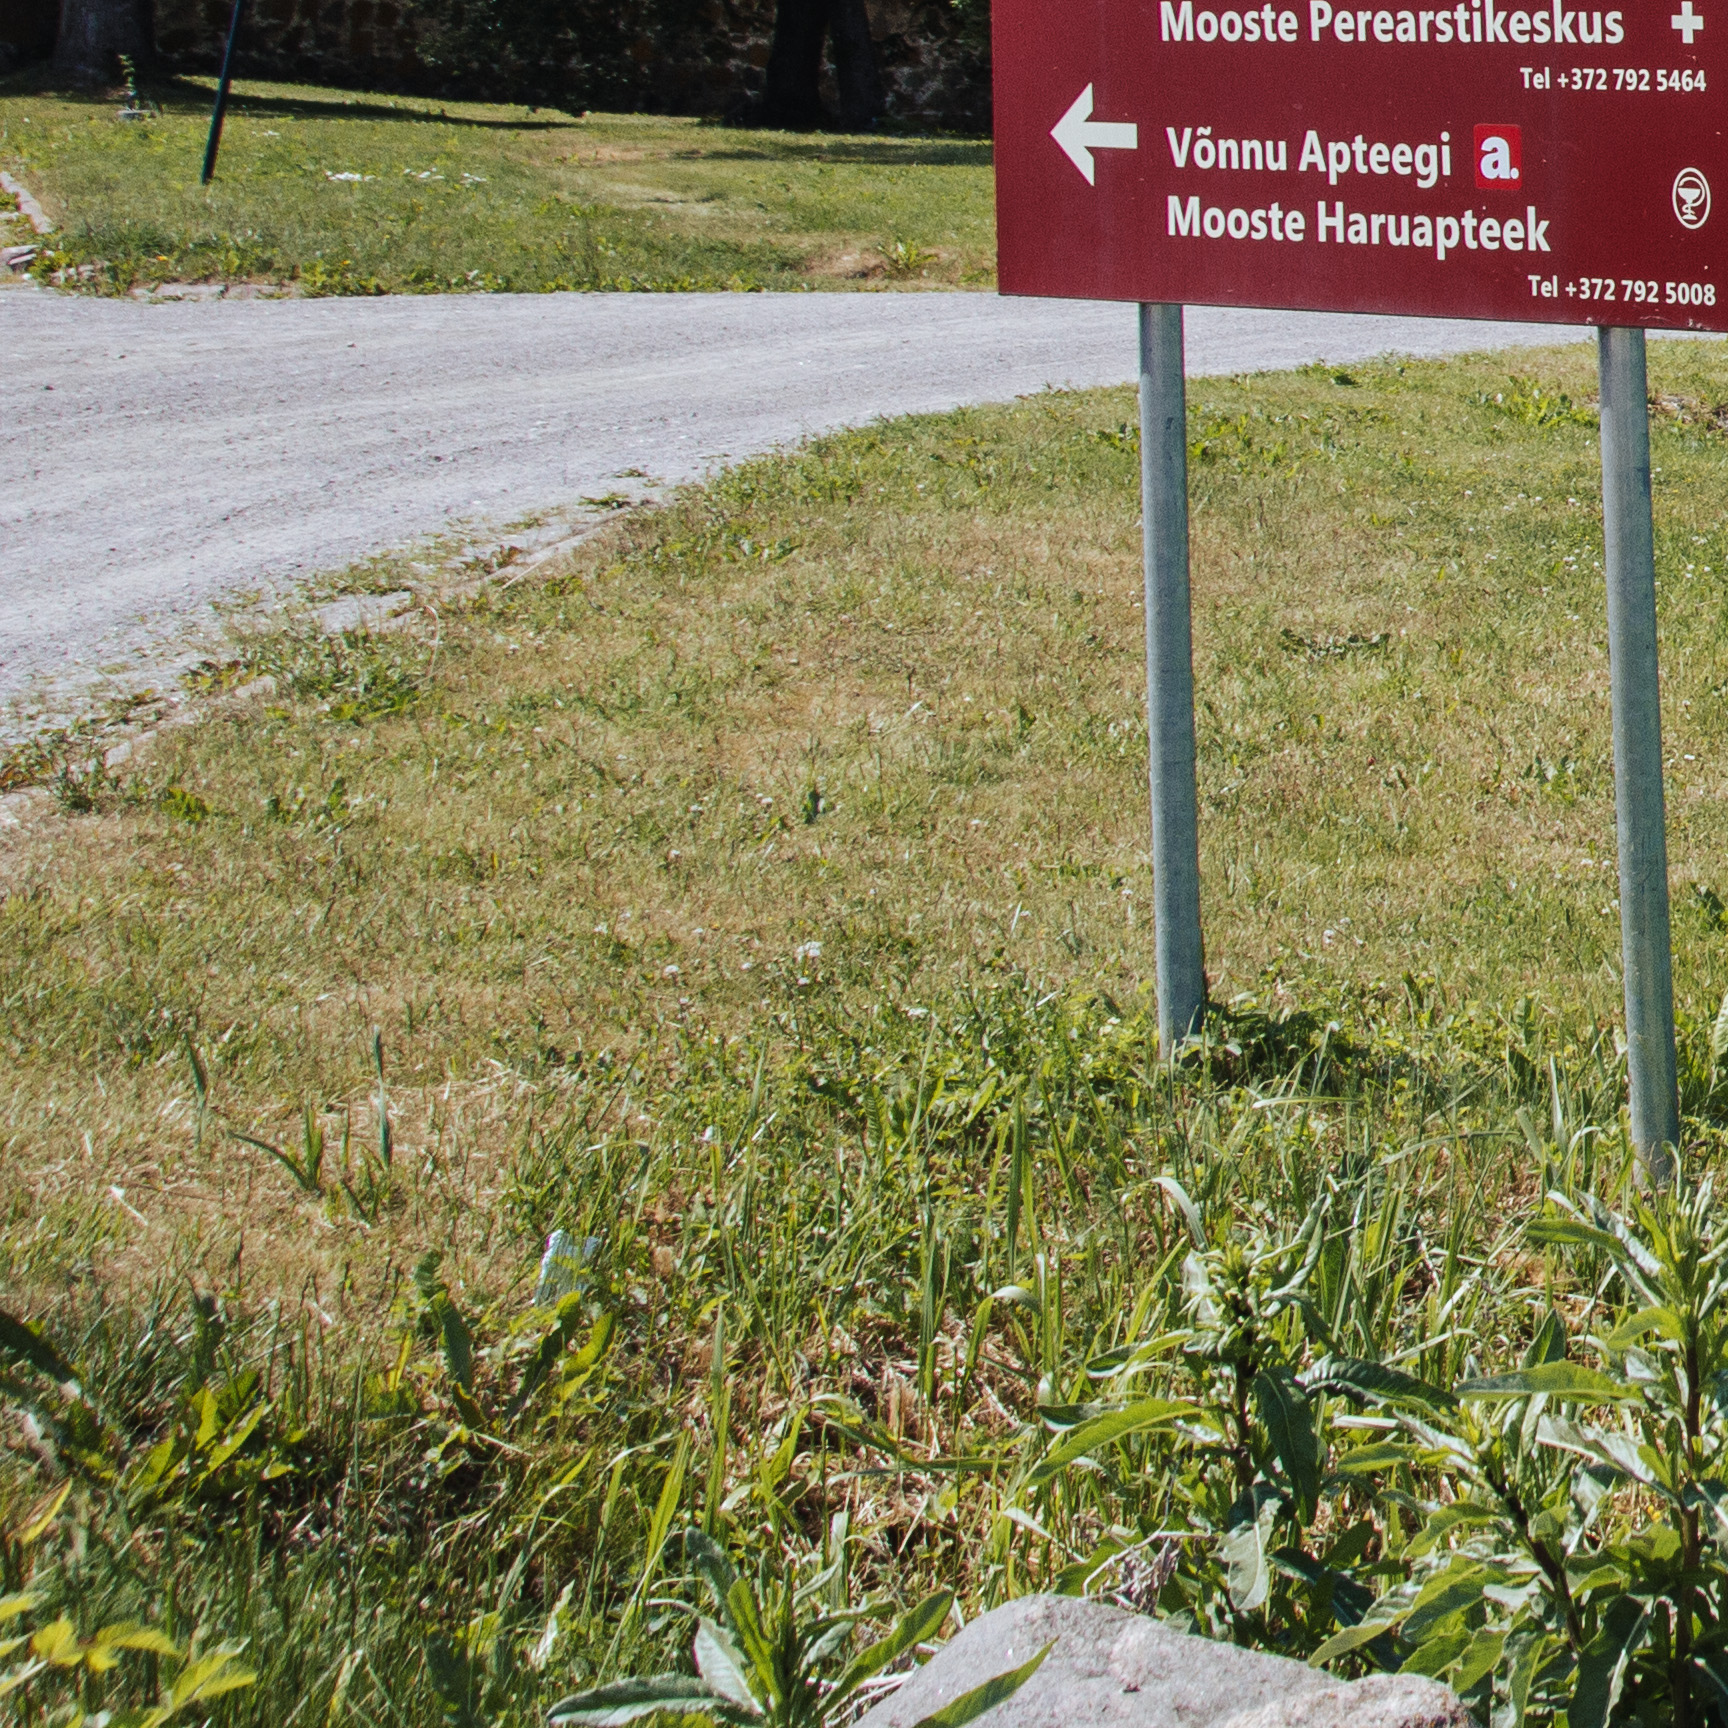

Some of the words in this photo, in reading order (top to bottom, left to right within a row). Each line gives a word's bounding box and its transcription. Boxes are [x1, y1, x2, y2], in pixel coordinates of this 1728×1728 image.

[1159, 0, 1299, 43] Mooste
[1520, 67, 1551, 90] Tel
[1556, 67, 1608, 91] +372
[1612, 68, 1651, 92] 792
[1656, 69, 1707, 93] 5464
[1166, 125, 1288, 171] Võnnu
[1298, 129, 1452, 188] Apteegi
[1166, 195, 1305, 241] Mooste
[1317, 201, 1551, 260] Haruapteek
[1528, 275, 1559, 298] Tel
[1565, 278, 1616, 302] +372
[1621, 279, 1660, 303] 792
[1665, 281, 1717, 306] 5008
